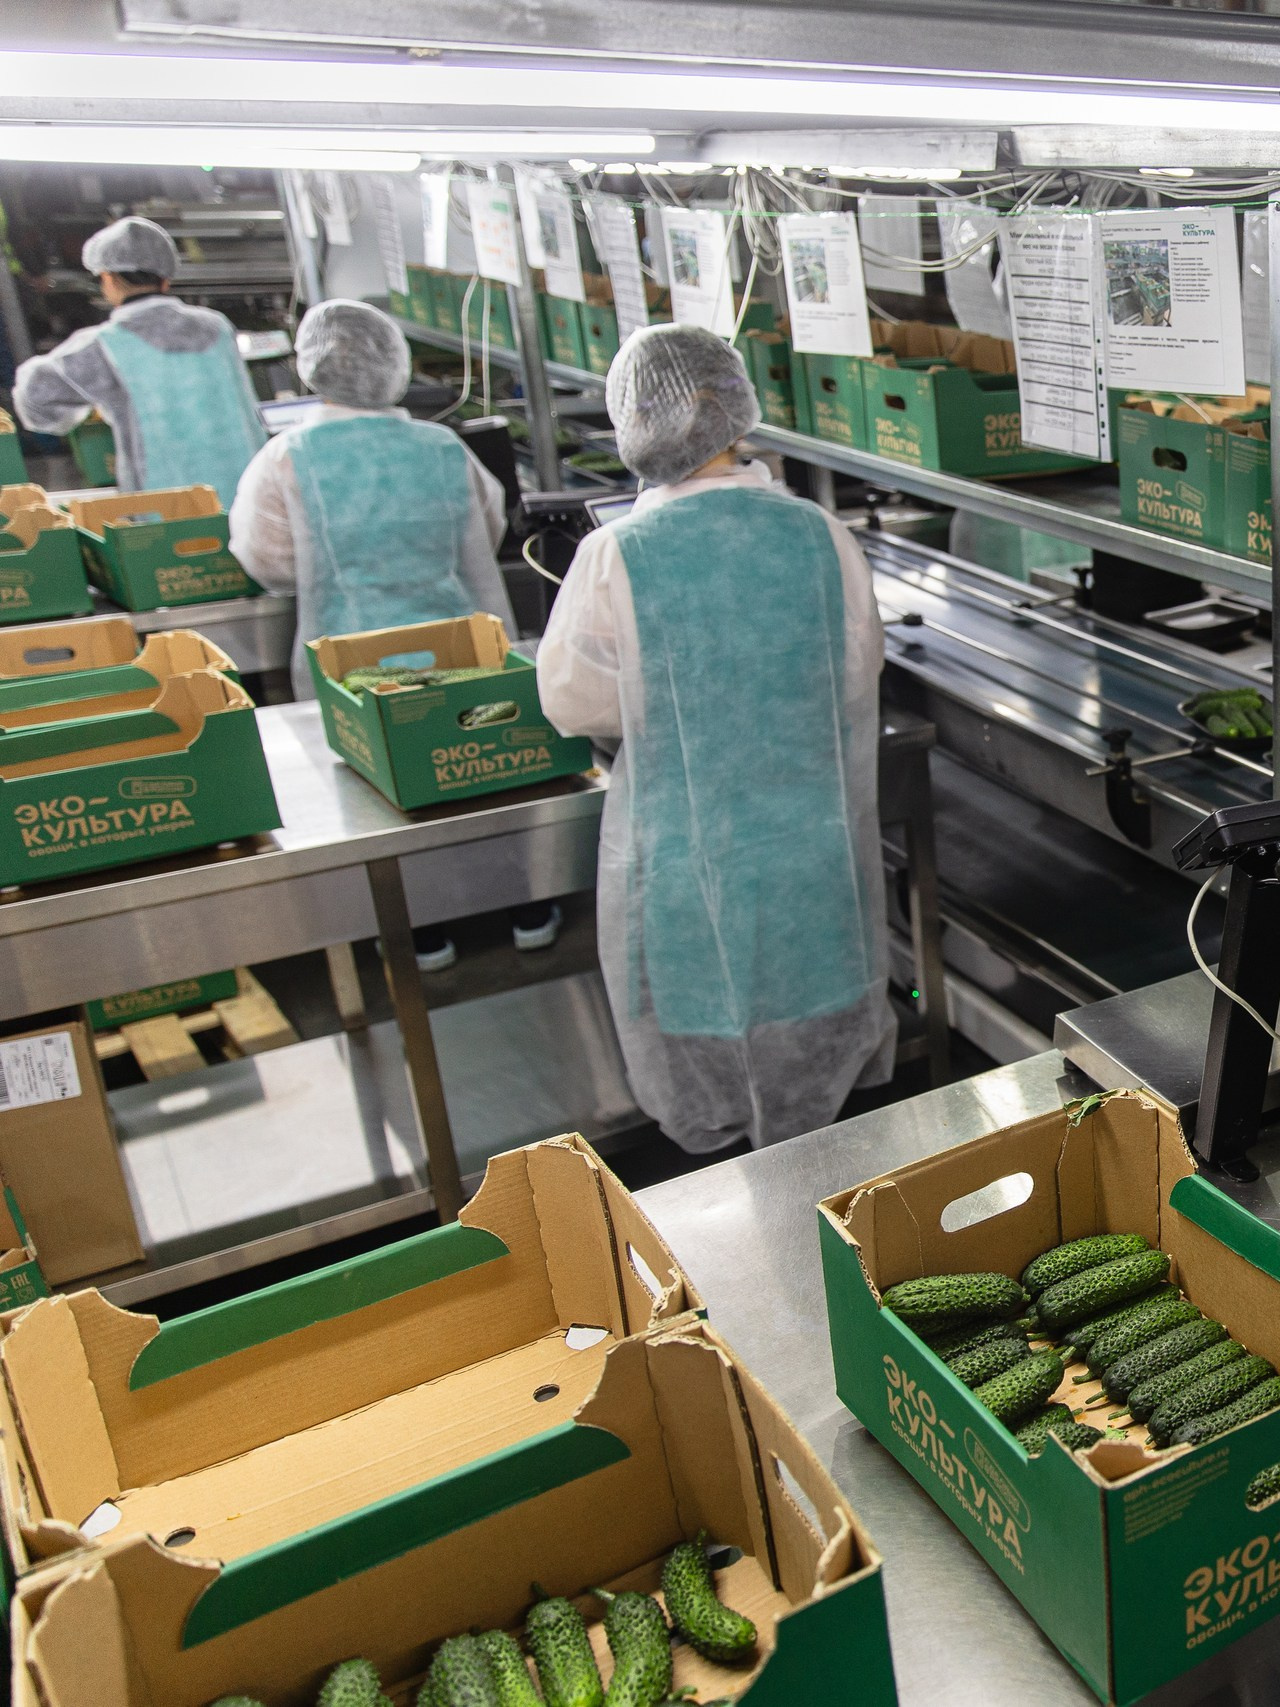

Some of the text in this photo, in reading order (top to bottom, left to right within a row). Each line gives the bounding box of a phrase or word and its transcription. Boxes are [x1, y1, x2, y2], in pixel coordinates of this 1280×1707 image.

[1137, 497, 1203, 529] КУЛЬТУРА
[434, 745, 551, 783] КУЛЬТУРА
[21, 799, 192, 848] КУЛЬТУРА
[886, 1385, 1023, 1559] КУЛЬТУРА
[890, 1420, 930, 1467] овощи,
[930, 1462, 937, 1474] в
[937, 1469, 984, 1527] которых
[985, 1521, 1026, 1576] уверен
[1186, 1610, 1245, 1650] овощи,
[1248, 1601, 1258, 1613] в
